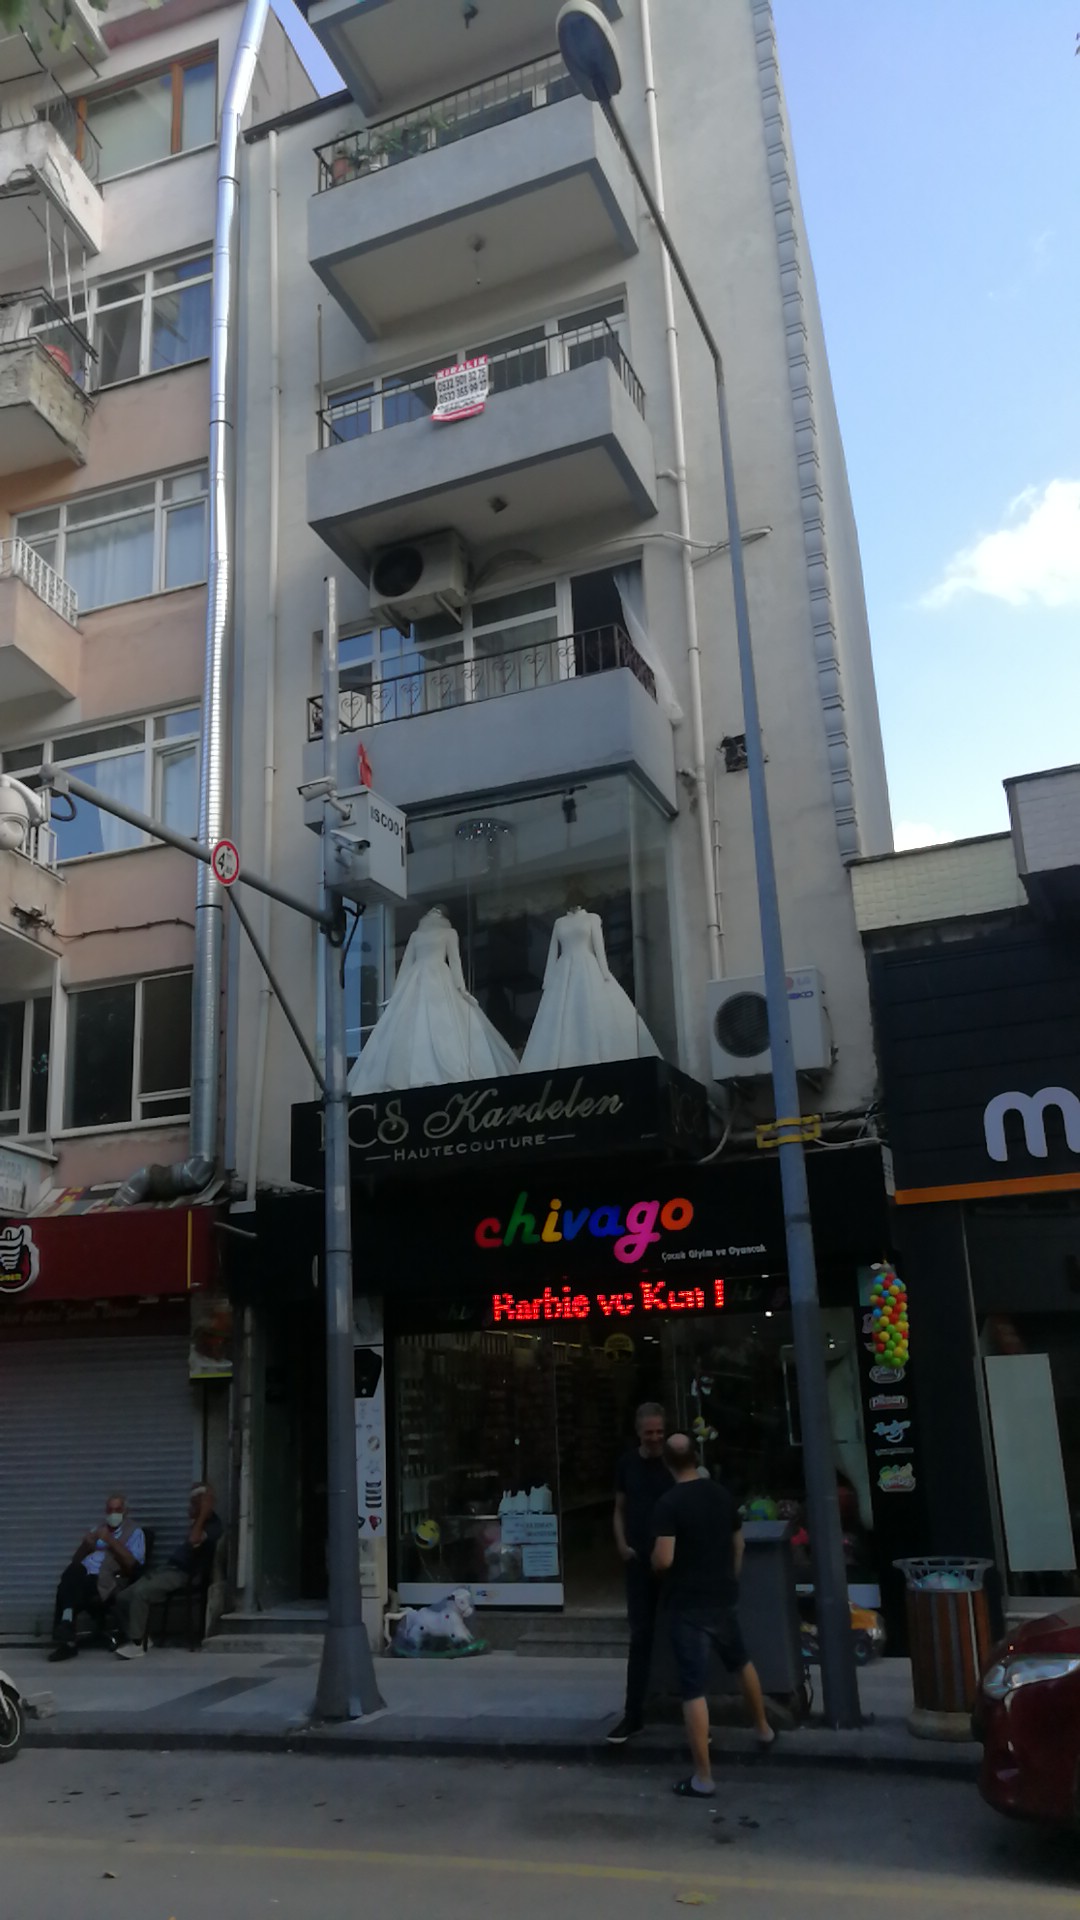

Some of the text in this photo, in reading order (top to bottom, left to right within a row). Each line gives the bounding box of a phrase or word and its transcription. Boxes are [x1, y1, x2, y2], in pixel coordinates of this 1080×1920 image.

[436, 356, 486, 379] KIRALIK
[424, 1077, 624, 1139] Kardelen
[474, 1191, 694, 1264] chivago
